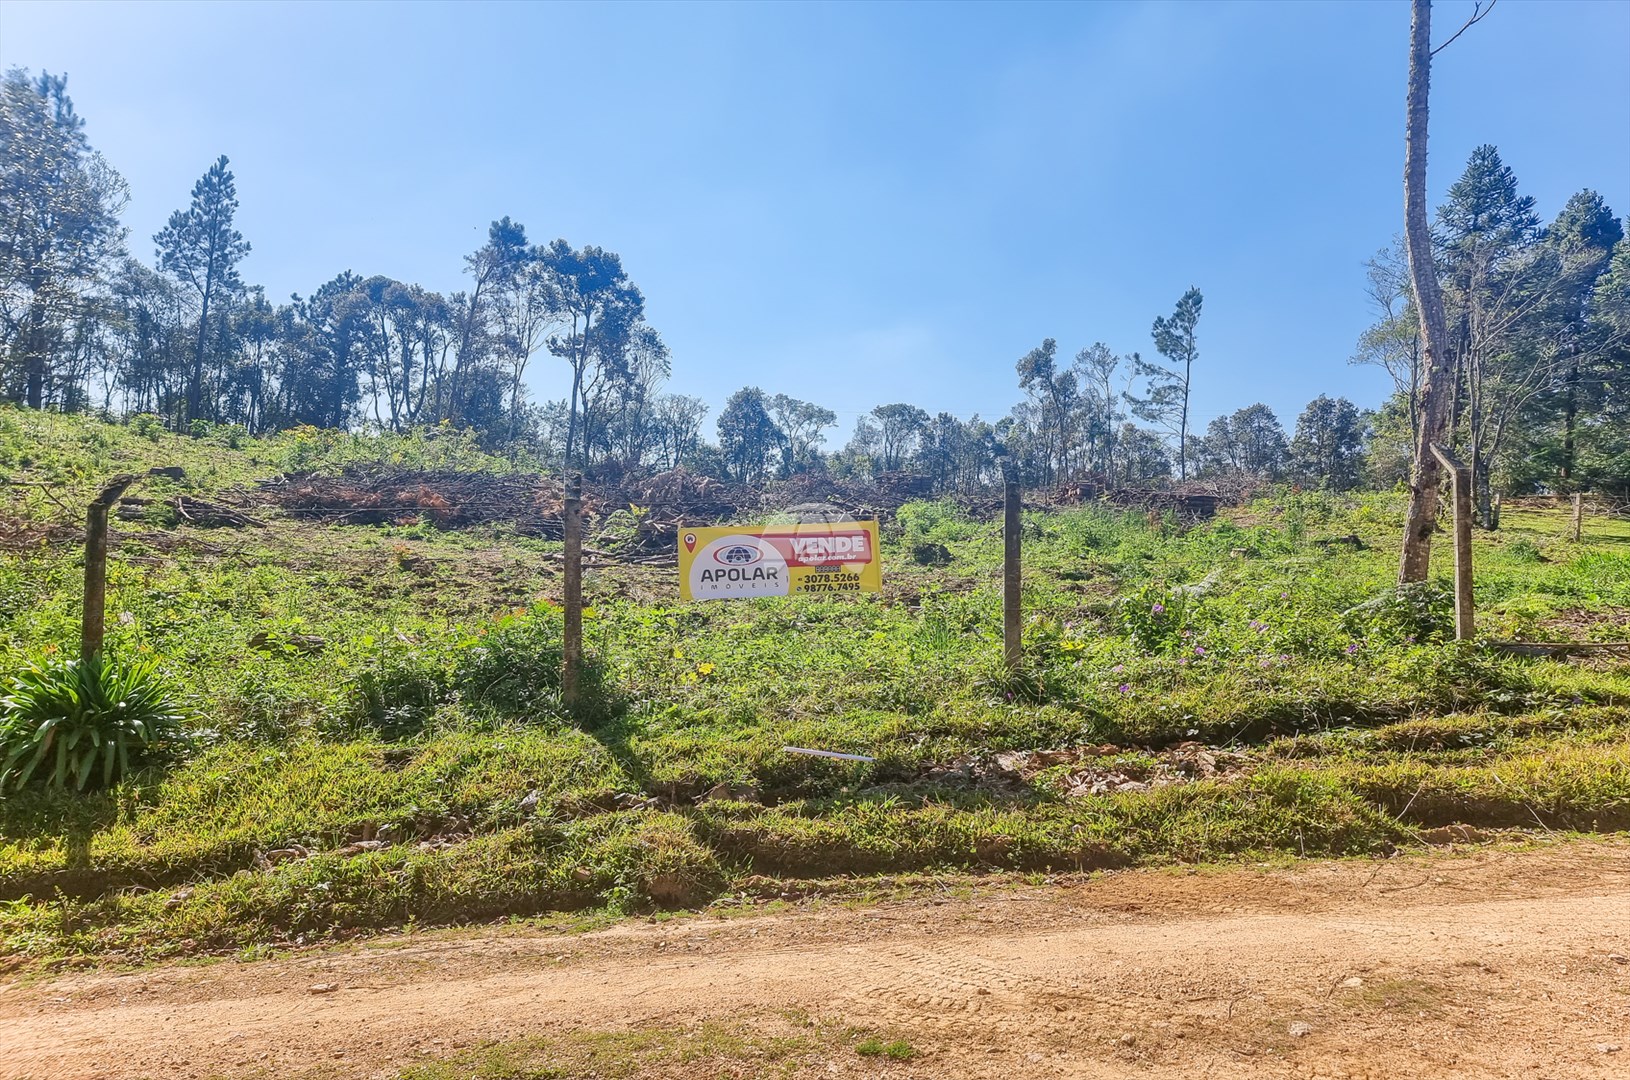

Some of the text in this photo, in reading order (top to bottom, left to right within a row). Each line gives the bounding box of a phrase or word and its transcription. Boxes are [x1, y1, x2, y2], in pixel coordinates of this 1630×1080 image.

[789, 535, 865, 553] VENDE
[798, 555, 857, 563] apolar.com.br
[701, 567, 778, 583] APOLAR
[804, 573, 860, 584] 3078.5266
[804, 583, 861, 592] 98776.7495
